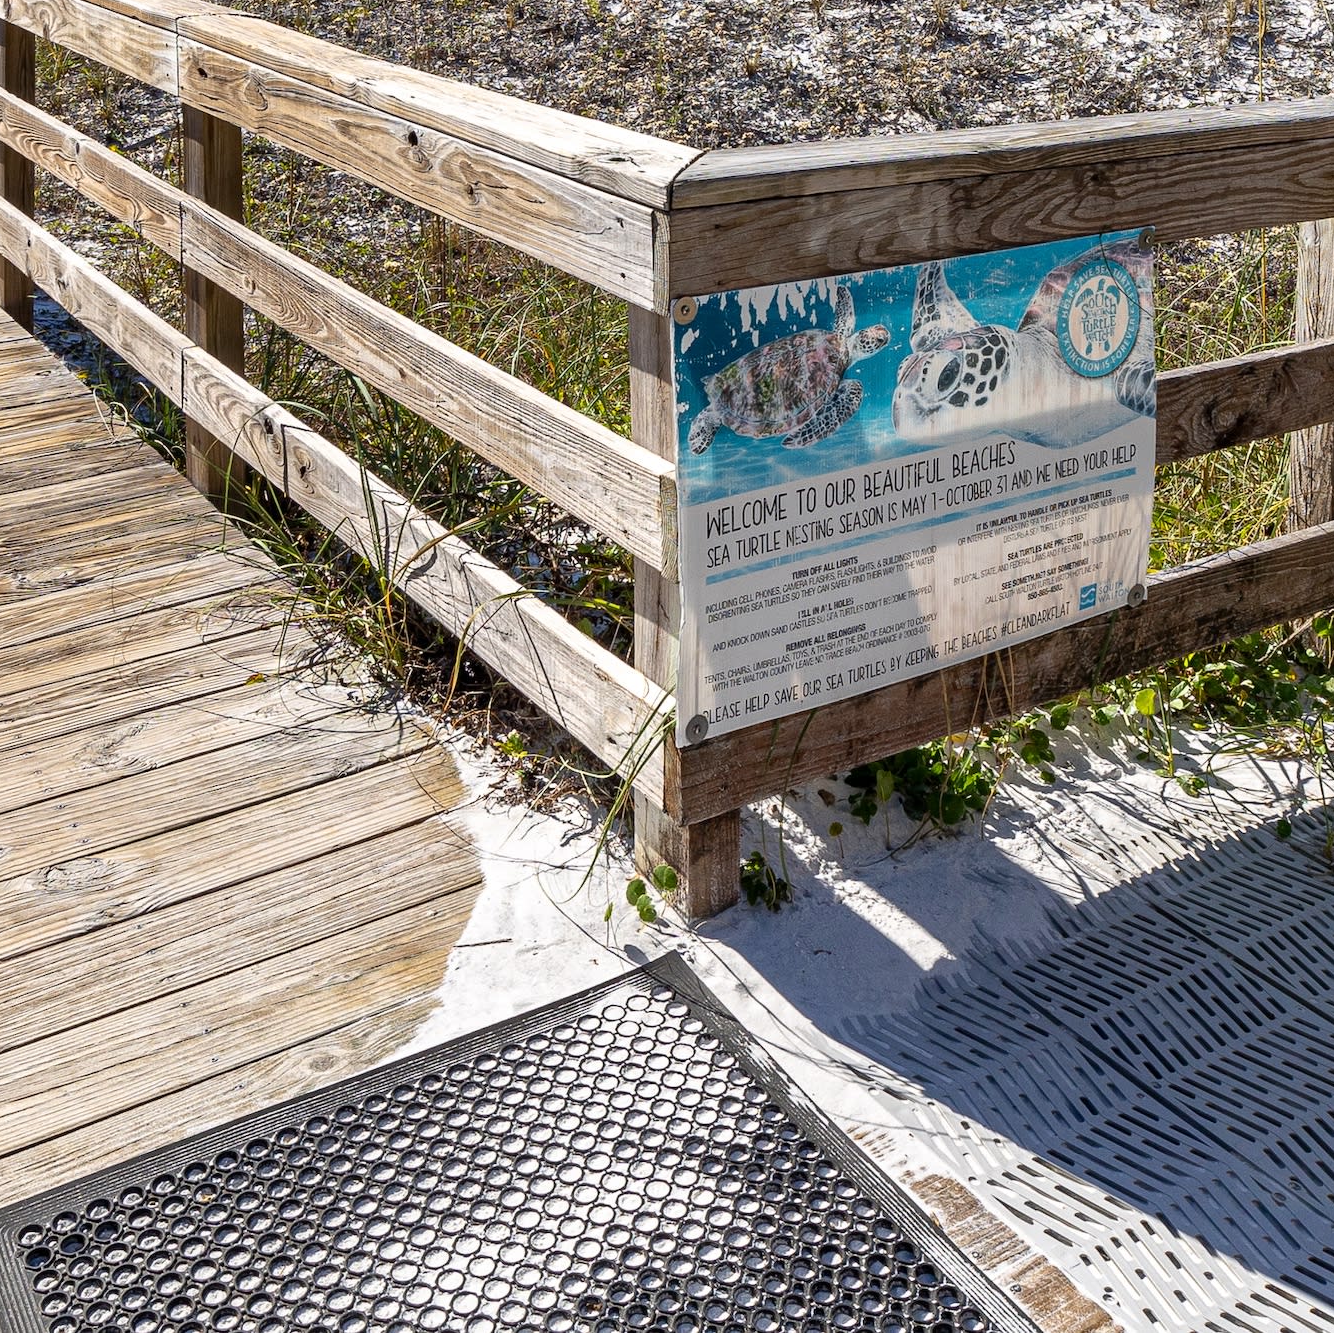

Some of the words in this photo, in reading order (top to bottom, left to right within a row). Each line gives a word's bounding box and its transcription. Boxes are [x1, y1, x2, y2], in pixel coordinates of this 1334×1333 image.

[1062, 290, 1074, 318] HELP
[1074, 268, 1093, 290] SAVE
[1113, 268, 1137, 305] TURTLES
[1061, 332, 1100, 372] EXTINCTION
[1102, 360, 1110, 370] IS
[1112, 318, 1136, 363] FOREVER
[1081, 316, 1116, 334] TURTLE
[706, 492, 787, 538] WELCOME
[796, 486, 816, 516] TO
[825, 477, 855, 509] OUR
[864, 456, 945, 499] BEAUTIFUL
[952, 440, 1014, 478] BEACHES
[706, 542, 729, 568] SEA
[736, 530, 780, 560] TURTLE
[786, 517, 833, 548] NESTING
[839, 505, 883, 534] SEASON
[888, 501, 896, 522] IS
[901, 494, 926, 518] MAY
[996, 474, 1007, 494] 31
[1012, 468, 1031, 490] AND
[1036, 464, 1050, 484] WE
[1055, 457, 1078, 479] NEED
[1083, 450, 1107, 472] YOUR
[1112, 443, 1136, 465] HELP
[976, 523, 981, 531] IT
[982, 521, 988, 529] IS
[1019, 511, 1026, 520] TO
[1027, 506, 1047, 517] HANDLE
[1049, 503, 1056, 512] OR
[1058, 500, 1070, 509] PICK
[1070, 498, 1077, 506] UP
[1078, 495, 1088, 504] SEA
[1089, 489, 1112, 501] TURTLES
[792, 568, 808, 580] TURN
[810, 565, 822, 575] OFF
[823, 561, 834, 571] ALL
[836, 555, 858, 568] LIGHTS
[1007, 551, 1018, 560] SEA
[1019, 544, 1042, 557] TURTLES
[1043, 541, 1052, 550] ARE
[705, 597, 737, 614] INCLUDING
[739, 593, 753, 605] CELL
[755, 585, 781, 600] PHONES,
[782, 578, 807, 593] CAMERA
[837, 560, 876, 578] FLASHLIGHTS,
[882, 551, 911, 566] BUILDINGS
[912, 549, 919, 558] TO
[920, 544, 936, 556] AVOID
[708, 604, 749, 623] DISORIENTING
[751, 601, 762, 612] SEA
[764, 593, 790, 608] TURTLES
[791, 591, 799, 601] SO
[801, 586, 815, 598] THEY
[817, 583, 829, 594] CAN
[830, 577, 851, 590] SAFELY
[852, 573, 865, 584] FIND
[866, 569, 882, 580] THEIR
[883, 565, 894, 576] WAY
[896, 563, 903, 572] TO
[905, 560, 915, 570] THE
[916, 555, 934, 567] WATER
[1001, 580, 1011, 590] SEE
[1046, 567, 1056, 576] SAY
[1098, 581, 1122, 594] SOUTH
[1098, 586, 1129, 603] WALTON
[713, 642, 726, 653] AND
[727, 636, 747, 649] KNOCK
[750, 629, 769, 643] DOWN
[771, 624, 787, 637] SAND
[789, 617, 815, 632] CASTLES
[864, 598, 882, 611] DON'T
[908, 584, 932, 598] TRAPPED
[813, 606, 819, 615] IN
[785, 637, 812, 652] REMOVE
[813, 634, 825, 644] ALL
[827, 622, 865, 641] BELONGINGS
[817, 640, 834, 653] TRASH
[836, 638, 842, 648] AT
[844, 634, 854, 645] THE
[857, 631, 868, 642] END
[870, 628, 878, 638] OF
[879, 623, 893, 635] EACH
[895, 620, 905, 631] DAY
[907, 618, 913, 627] TO
[915, 611, 937, 625] COMPLY
[712, 680, 728, 694] WITH
[730, 677, 741, 688] THE
[743, 669, 768, 685] WALTON
[770, 662, 793, 677] COUNTY
[795, 656, 812, 670] LEAVE
[825, 647, 843, 661] TRACE
[745, 692, 769, 714] HELP
[774, 683, 798, 705] SAVE
[803, 676, 821, 696] OUR
[826, 670, 843, 689] SEA
[847, 657, 885, 683] TURTLES
[890, 652, 901, 670] BY
[905, 641, 939, 665] KEEPING
[944, 635, 958, 653] THE
[962, 623, 997, 648] BEACHES
